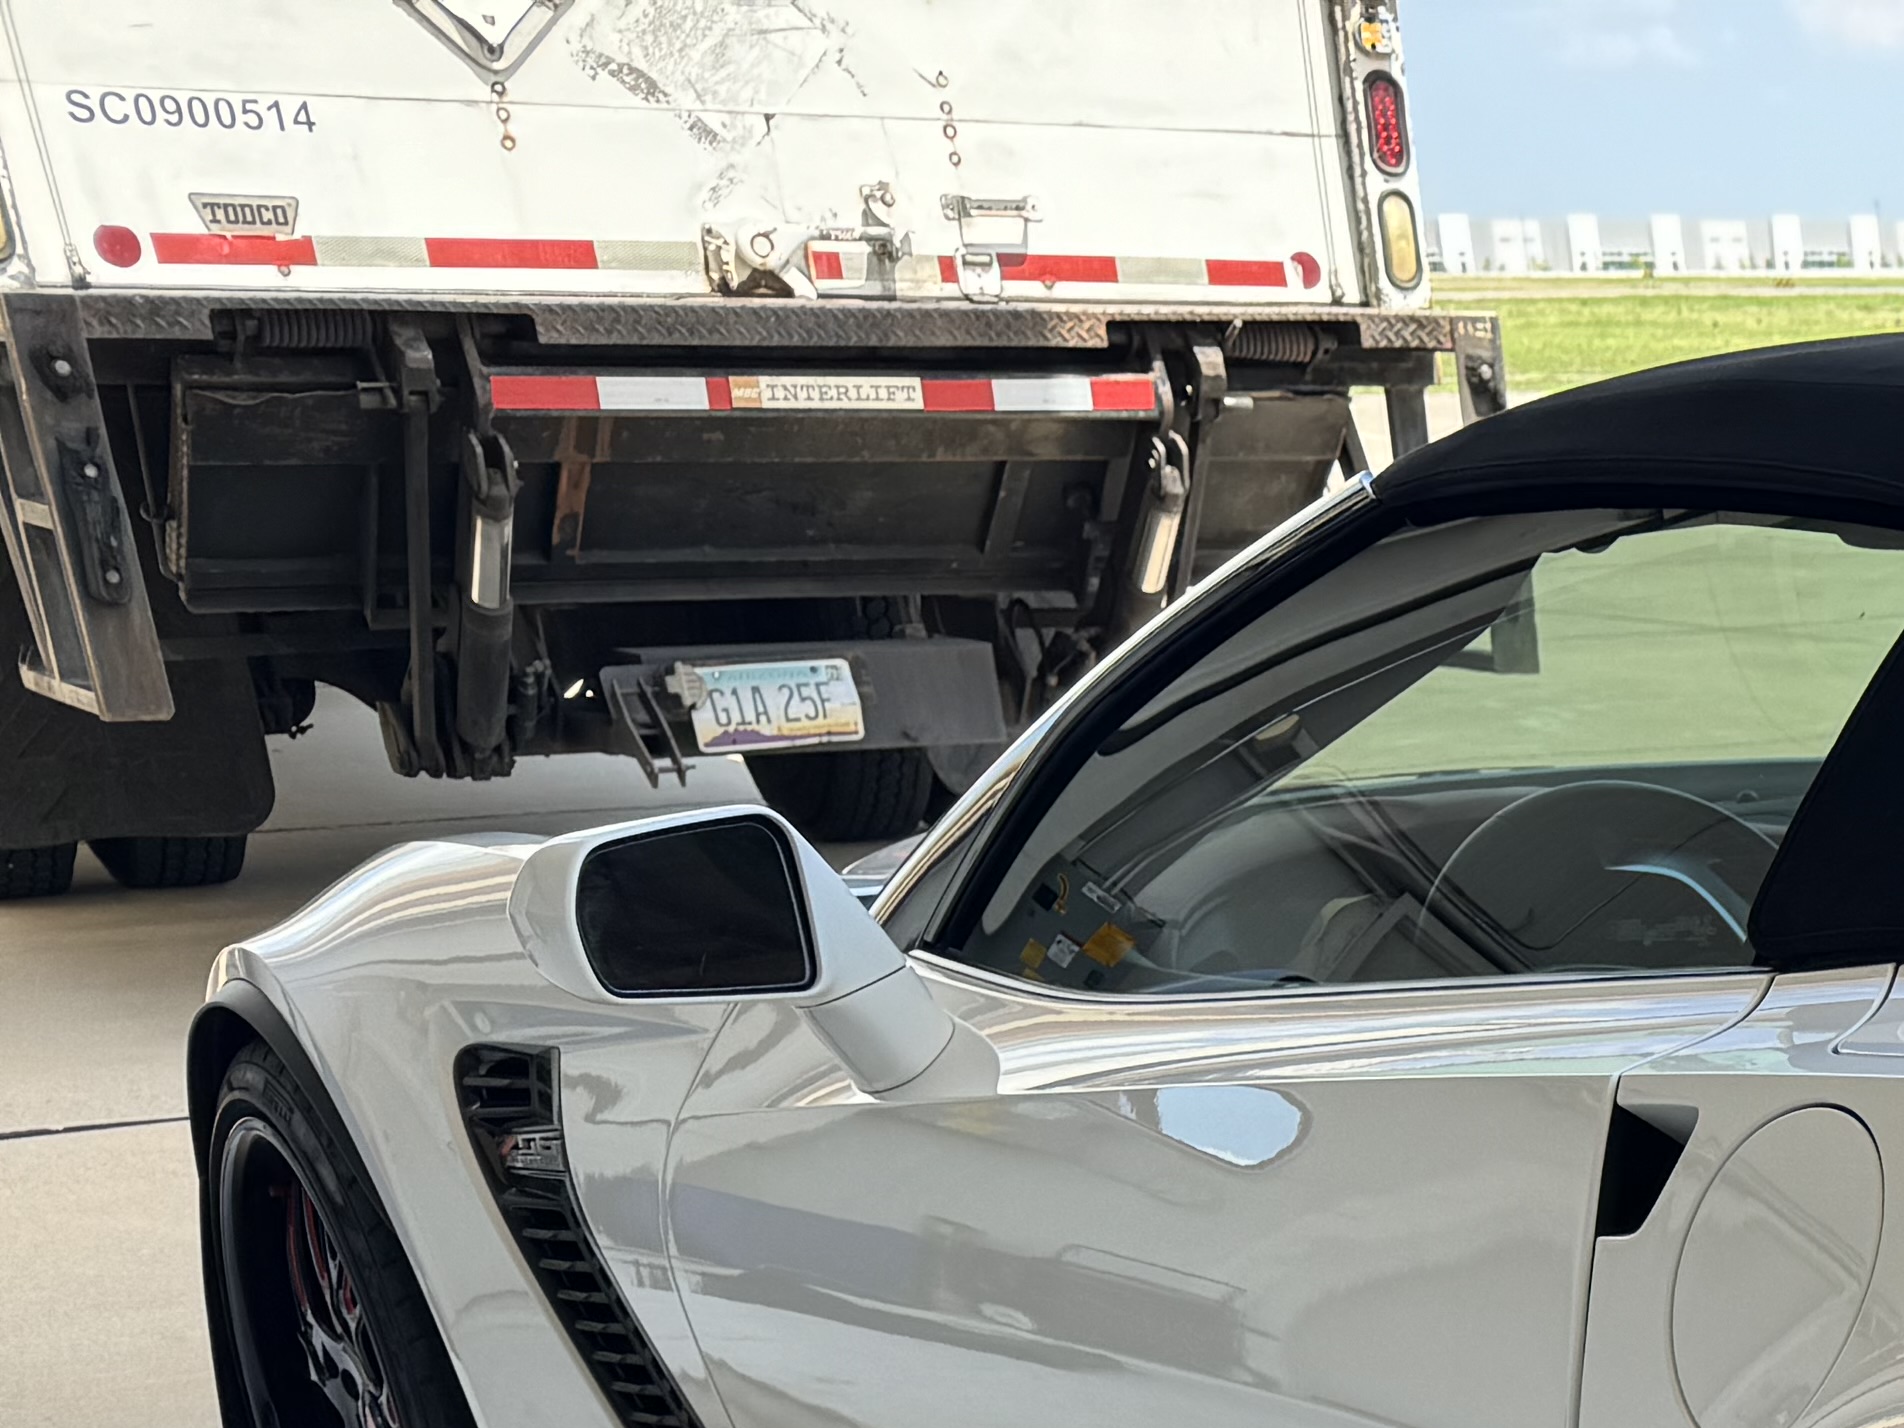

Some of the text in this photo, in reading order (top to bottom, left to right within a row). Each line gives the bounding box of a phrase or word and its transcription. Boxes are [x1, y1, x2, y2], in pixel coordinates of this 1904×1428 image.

[65, 88, 317, 133] SC0900514
[201, 202, 290, 226] TODCO
[765, 383, 917, 402] INTERLIFT
[708, 680, 832, 728] G1A 25F
